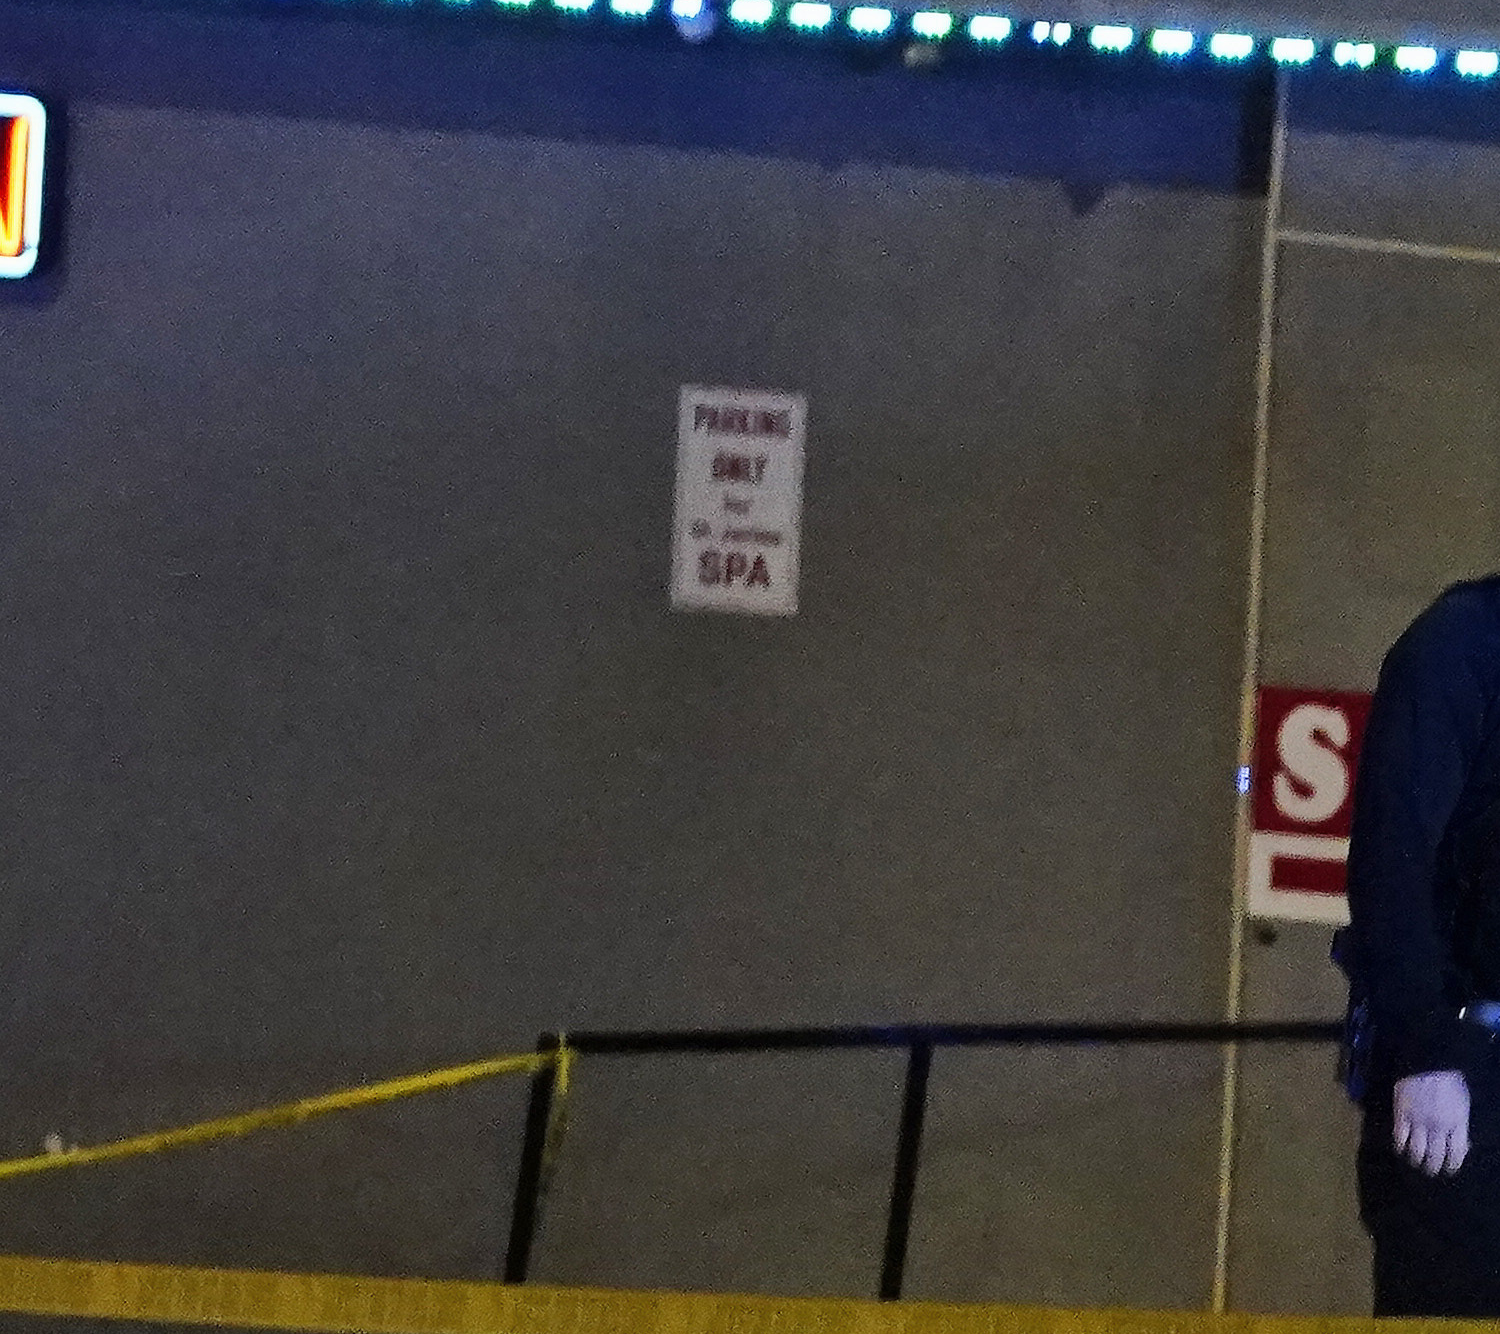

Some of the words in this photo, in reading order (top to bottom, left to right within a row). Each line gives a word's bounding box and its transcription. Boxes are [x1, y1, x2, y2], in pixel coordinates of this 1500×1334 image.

[694, 403, 791, 439] PARKING
[712, 453, 768, 486] ONLY
[699, 550, 772, 588] SPA
